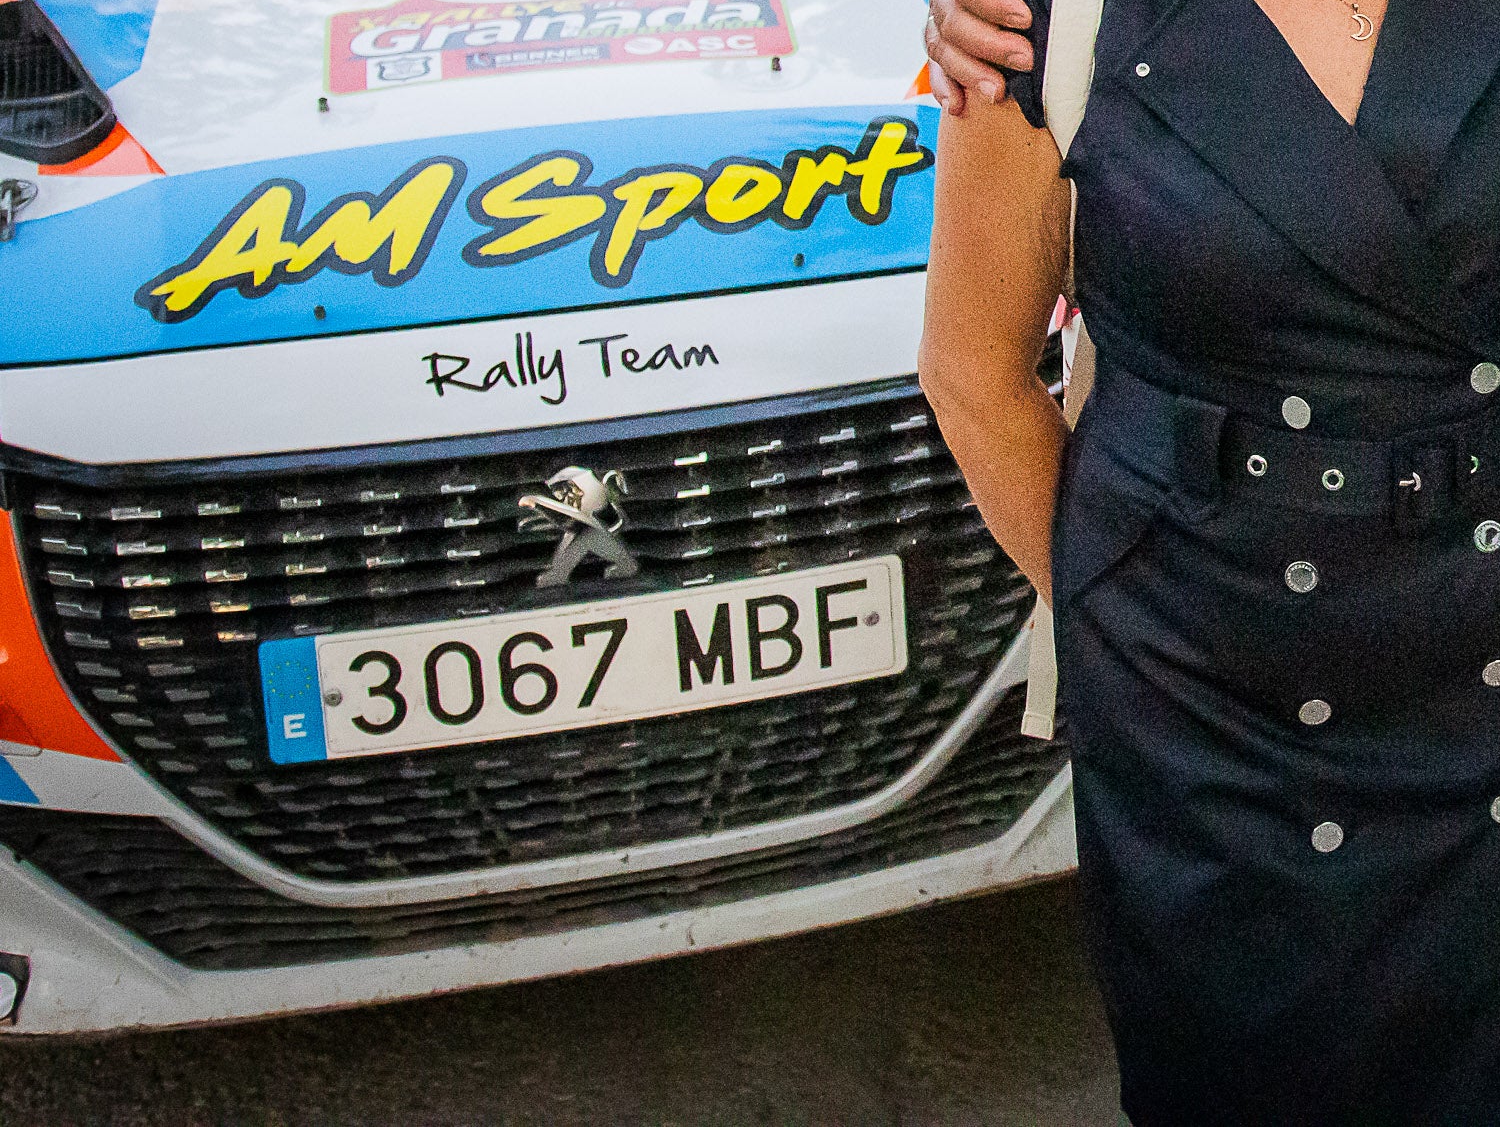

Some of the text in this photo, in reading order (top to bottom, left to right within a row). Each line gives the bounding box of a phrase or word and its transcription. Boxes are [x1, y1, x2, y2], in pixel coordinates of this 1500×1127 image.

[664, 34, 757, 53] ASC
[471, 116, 930, 281] Sport
[421, 332, 720, 406] Rally Team
[347, 578, 869, 736] 3067 MBF
[283, 712, 307, 740] E
